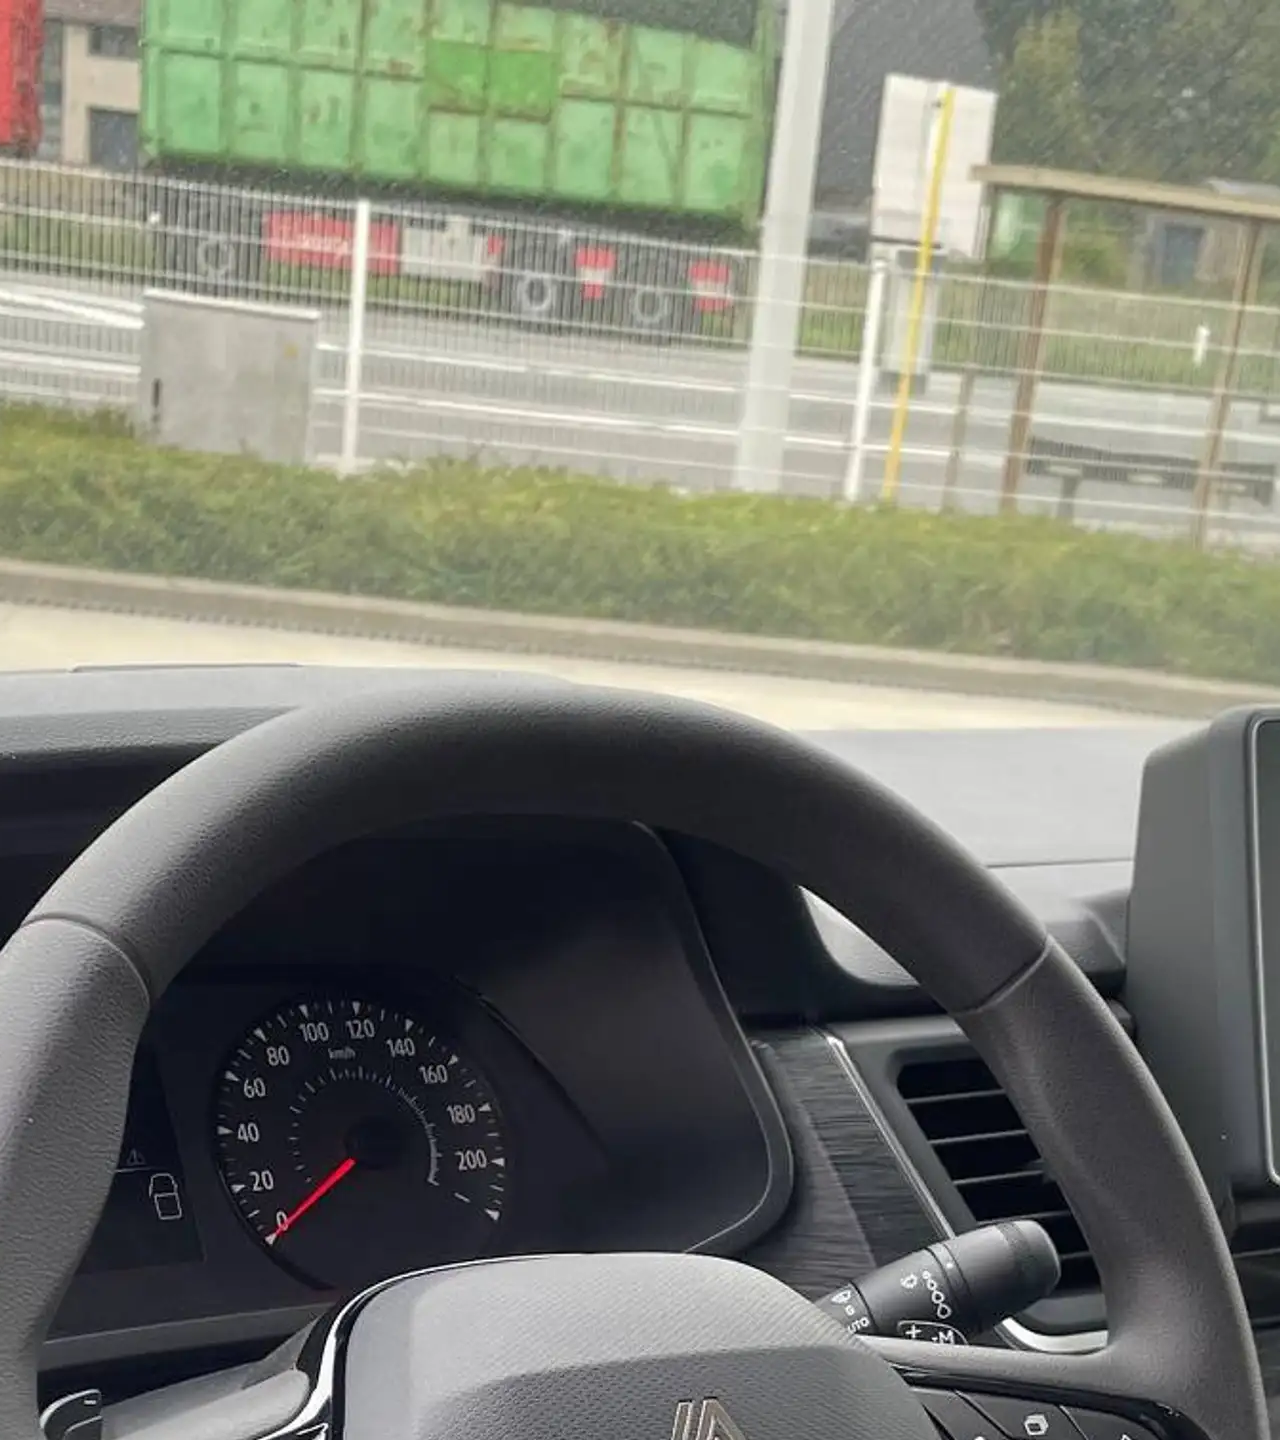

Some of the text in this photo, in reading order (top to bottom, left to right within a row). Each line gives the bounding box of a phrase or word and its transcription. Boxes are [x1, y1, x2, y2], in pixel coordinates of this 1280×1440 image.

[299, 1022, 329, 1043] 100
[346, 1020, 375, 1040] 120
[267, 1046, 290, 1067] 80
[386, 1037, 415, 1059] 140
[420, 1065, 449, 1085] 160
[243, 1078, 266, 1099] 60
[447, 1103, 476, 1125] 180
[236, 1122, 260, 1144] 40
[455, 1149, 487, 1171] 200
[251, 1170, 274, 1191] 20
